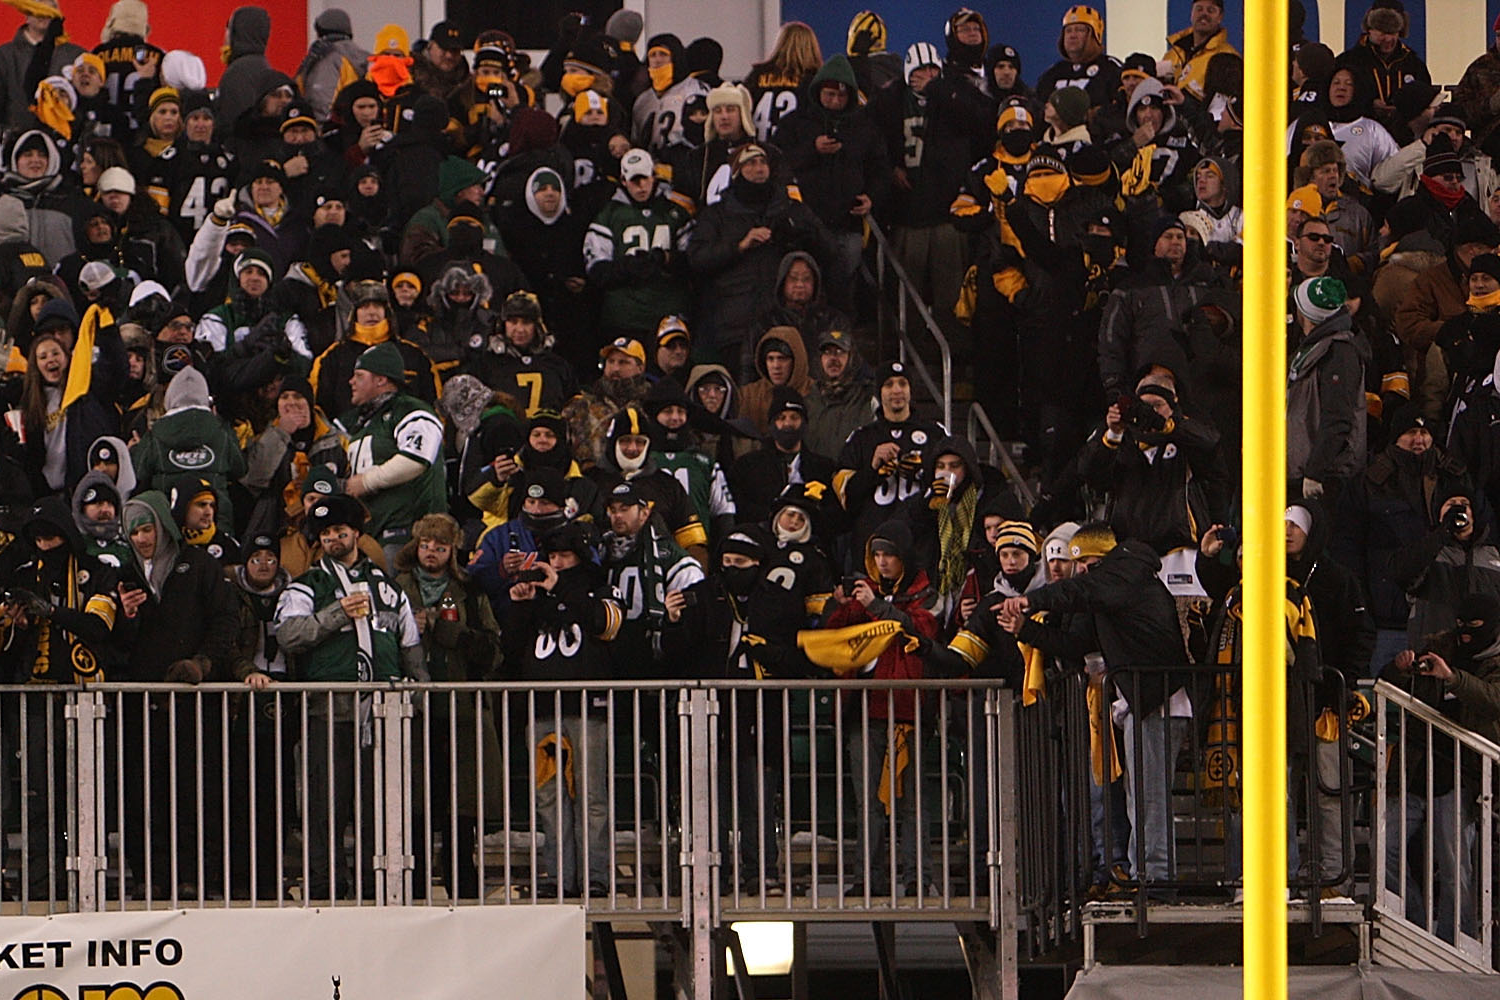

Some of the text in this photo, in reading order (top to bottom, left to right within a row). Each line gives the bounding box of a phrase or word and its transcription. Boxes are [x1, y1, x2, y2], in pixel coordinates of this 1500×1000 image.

[515, 371, 543, 419] 7
[405, 434, 424, 451] 74
[87, 938, 183, 968] INFO
